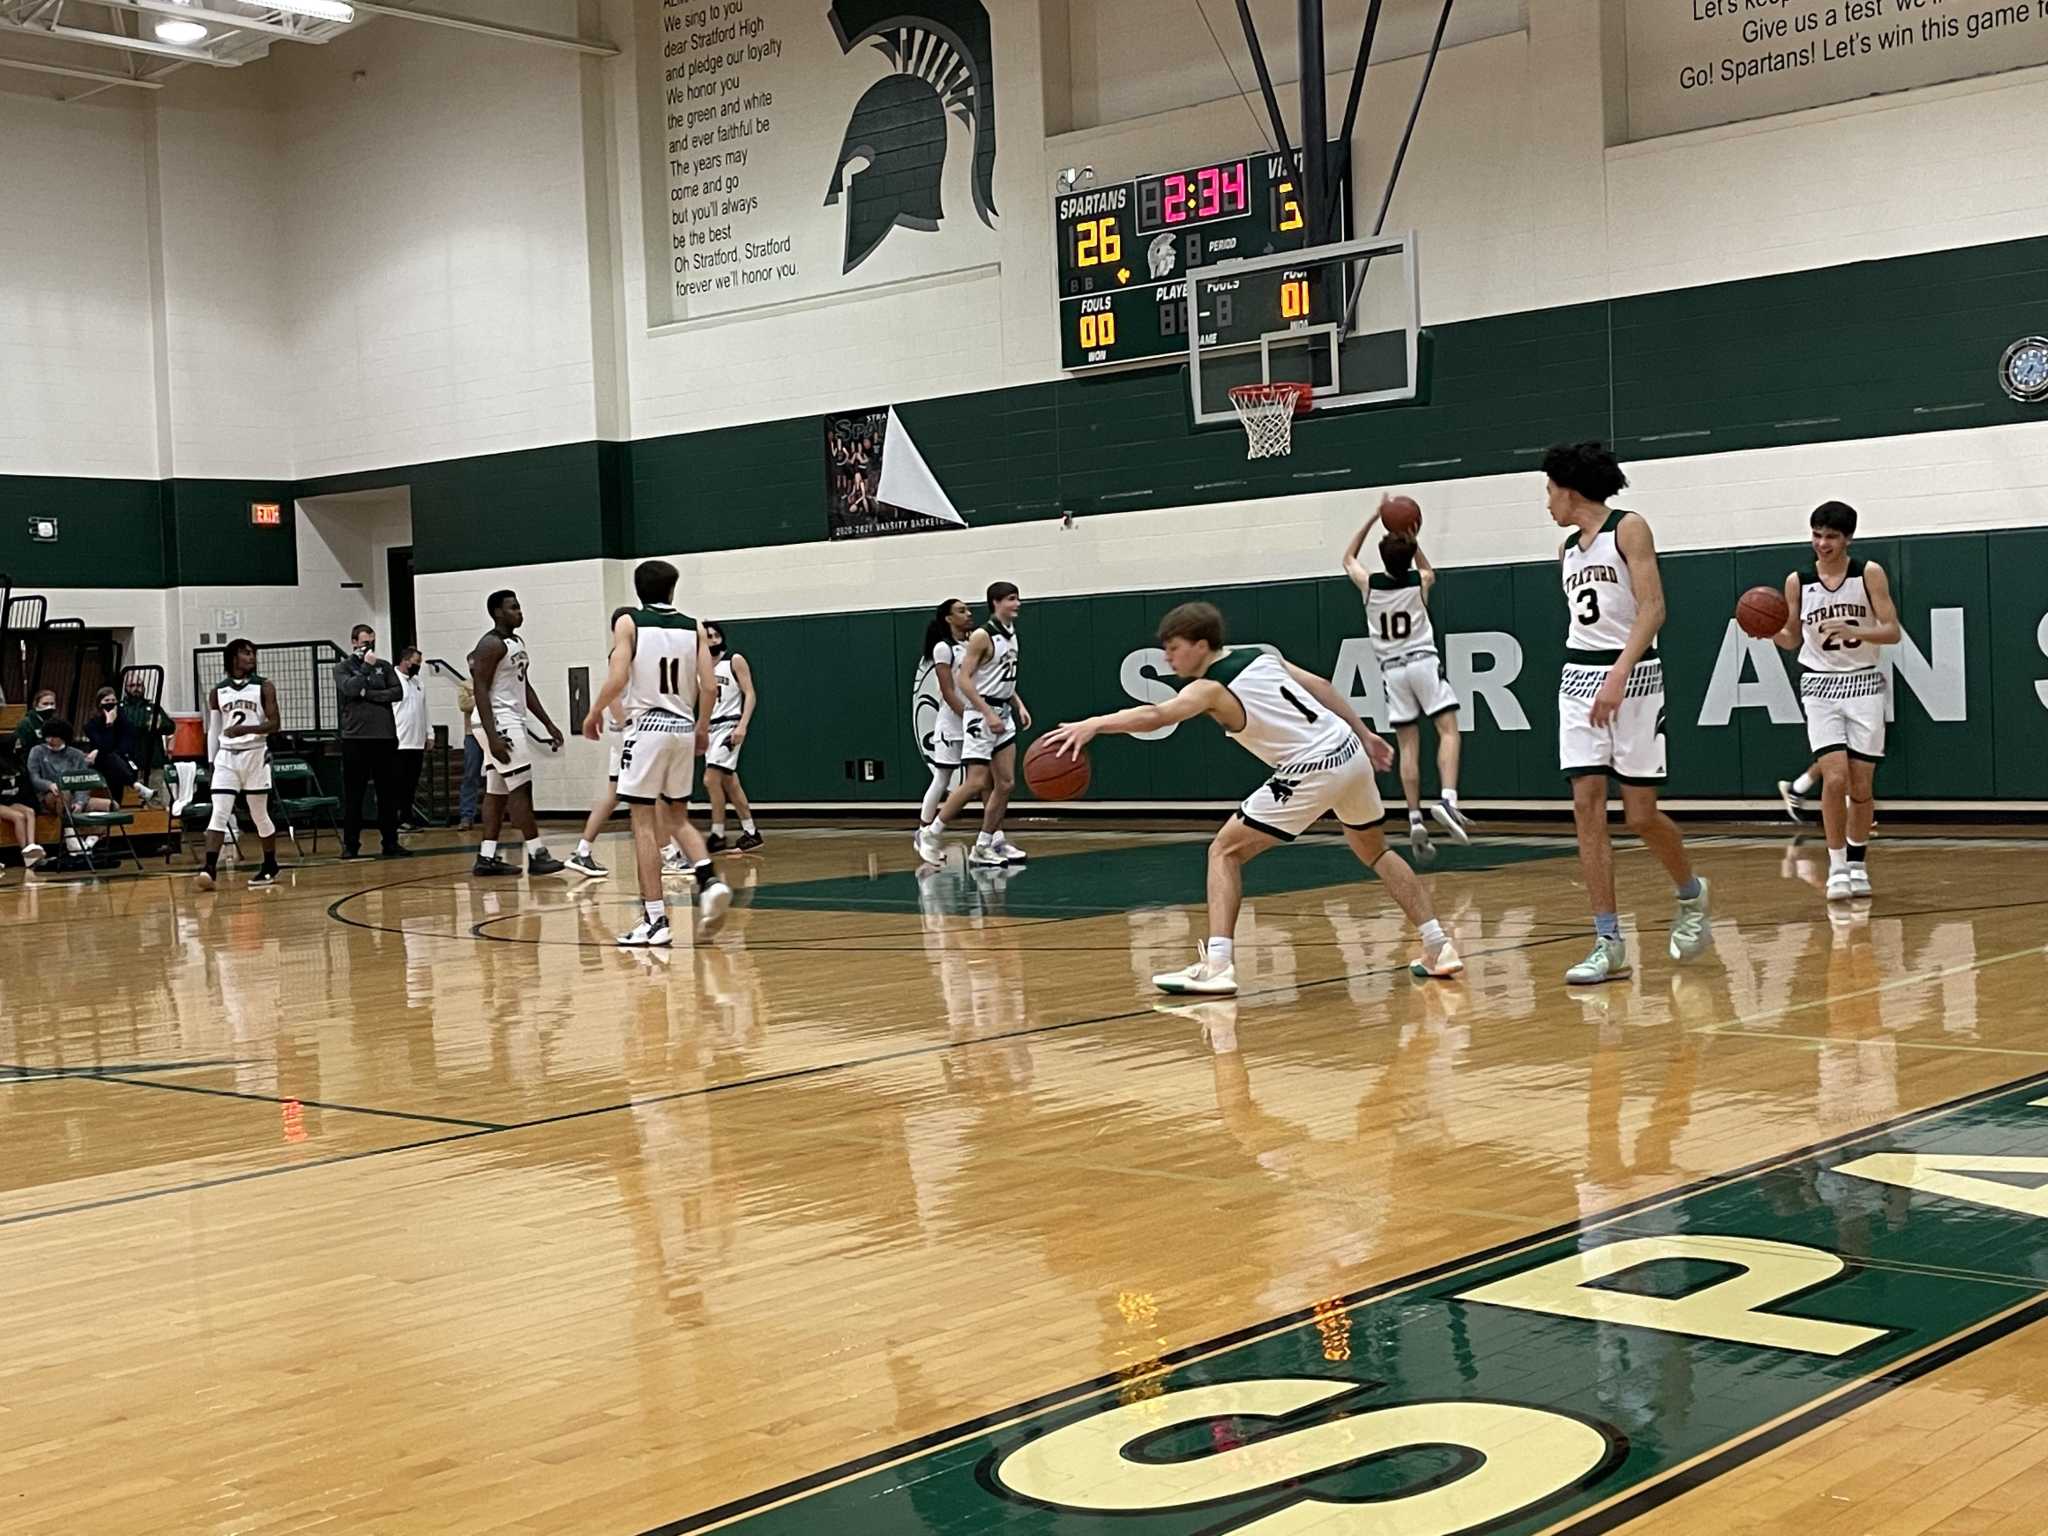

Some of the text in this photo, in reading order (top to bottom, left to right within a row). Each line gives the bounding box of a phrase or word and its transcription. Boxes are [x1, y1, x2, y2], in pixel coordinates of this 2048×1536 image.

[664, 0, 743, 32] We sing to you
[1743, 19, 1787, 42] Give
[1795, 13, 1818, 32] us
[1825, 9, 1837, 26] a
[1845, 1, 1882, 22] test
[664, 17, 764, 57] dear Stratford High
[1680, 62, 1713, 89] Go!
[1721, 42, 1815, 84] Spartans!
[1823, 33, 1872, 61] Let's
[1878, 24, 1913, 50] win
[1922, 15, 1959, 41] this
[1966, 4, 2030, 38] game
[665, 39, 782, 81] and pledge our loyalty
[666, 76, 740, 105] We honor you
[667, 92, 772, 130] the green and white
[668, 118, 770, 153] and ever faithful be
[670, 148, 748, 177] The years may
[671, 175, 739, 201] come and go
[1060, 188, 1127, 220] SPARTANS
[1164, 163, 1245, 223] 2:34
[672, 195, 758, 226] but you'll always
[673, 224, 732, 249] be the best
[1076, 217, 1121, 267] 26
[1208, 237, 1237, 252] PERIOD
[674, 256, 690, 273] Oh
[744, 235, 791, 260] Stratford
[676, 278, 712, 296] forever
[715, 270, 738, 290] we'll
[741, 267, 773, 285] honor
[1080, 280, 1310, 348] 00 01
[1081, 296, 1112, 314] FOULS
[1156, 284, 1189, 302] PLAYE
[1088, 333, 1218, 362] WON AME
[1576, 587, 1600, 626] 3
[1807, 603, 1866, 625] STRATFORD
[1379, 611, 1412, 641] 10
[659, 657, 679, 695] 11
[1280, 685, 1318, 724] 1
